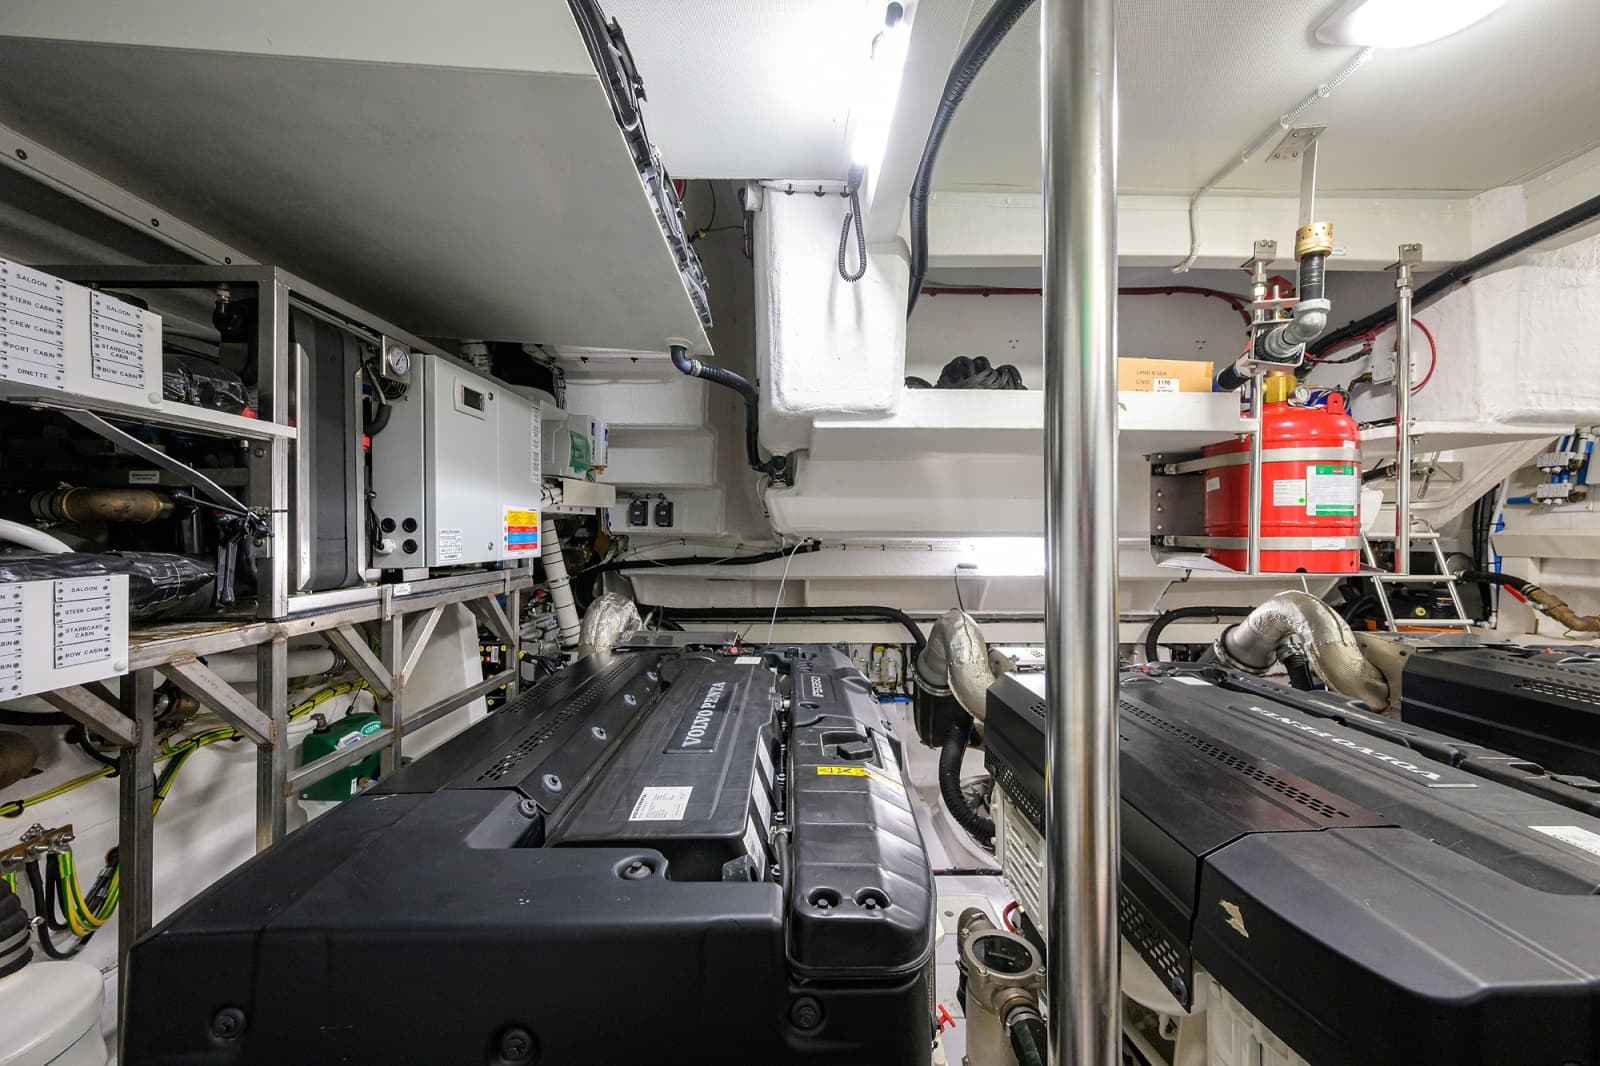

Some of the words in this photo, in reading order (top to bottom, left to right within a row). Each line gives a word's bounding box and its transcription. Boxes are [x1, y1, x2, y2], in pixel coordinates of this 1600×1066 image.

[16, 273, 48, 288] SALOON
[9, 295, 32, 307] STERN
[34, 301, 55, 313] CABIN
[106, 305, 131, 317] SALOON
[9, 319, 31, 330] CREW
[33, 324, 54, 335] CABIN
[101, 324, 119, 334] STERN
[120, 329, 137, 339] CABIN
[9, 343, 29, 353] PORT
[33, 349, 55, 359] CABIN
[101, 343, 137, 357] STARBOARD
[110, 351, 129, 360] CABIN
[17, 368, 49, 379] DINETTE
[102, 366, 118, 374] BOW
[119, 370, 138, 380] CABIN
[65, 625, 103, 634] STARBOARD
[682, 710, 714, 748] VOLVO
[703, 682, 727, 710] PENTA
[1249, 706, 1333, 738] PENTA
[1332, 737, 1441, 781] VOLVO
